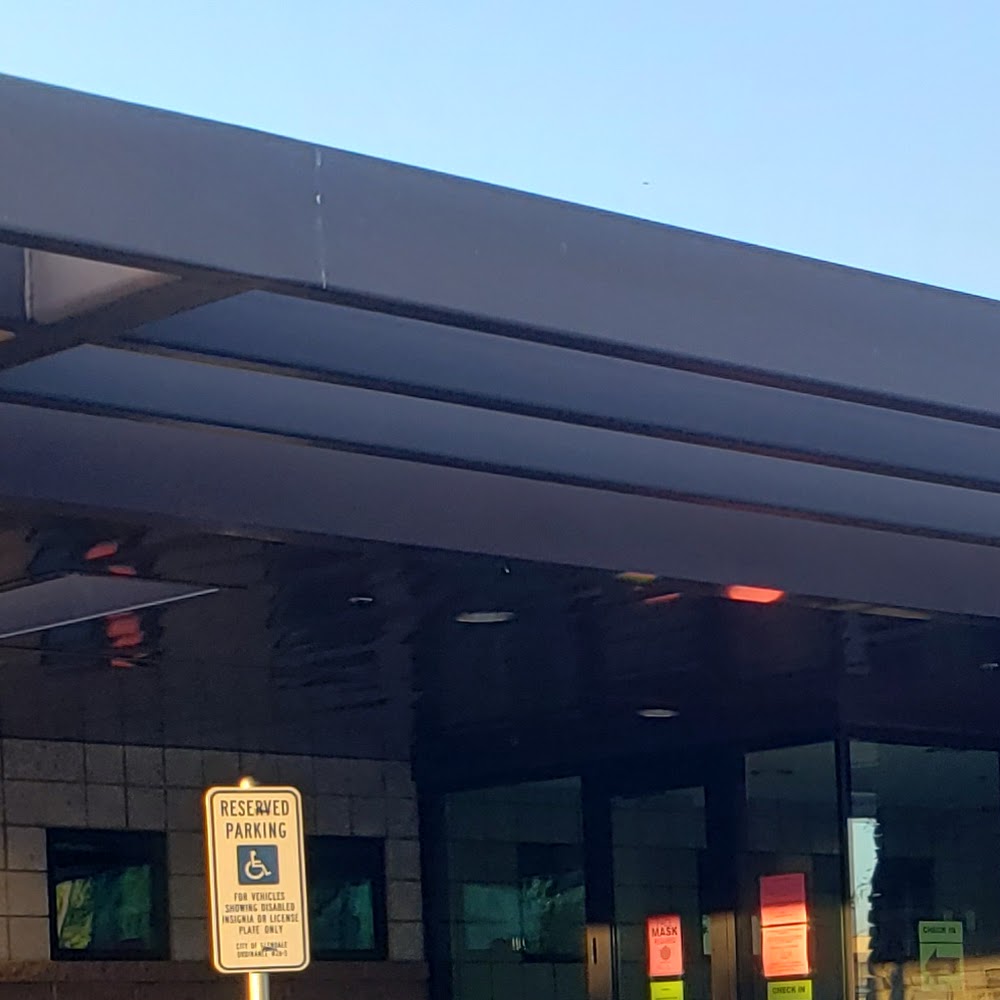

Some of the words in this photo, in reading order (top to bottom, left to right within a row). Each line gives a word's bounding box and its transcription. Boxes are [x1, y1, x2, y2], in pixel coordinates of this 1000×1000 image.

[220, 799, 290, 817] RESERVED
[225, 822, 287, 839] PARKING
[233, 892, 248, 902] FOR
[251, 891, 286, 901] VEHICLES
[224, 903, 258, 913] SHOWING
[261, 902, 296, 912] DISABLED
[222, 914, 254, 924] INSIGNIA
[257, 914, 267, 923] OR
[269, 913, 299, 923] LICENSE
[238, 925, 260, 935] PLATE
[264, 925, 283, 934] ONLY
[651, 926, 678, 937] MASK
[772, 986, 796, 994] CHECK
